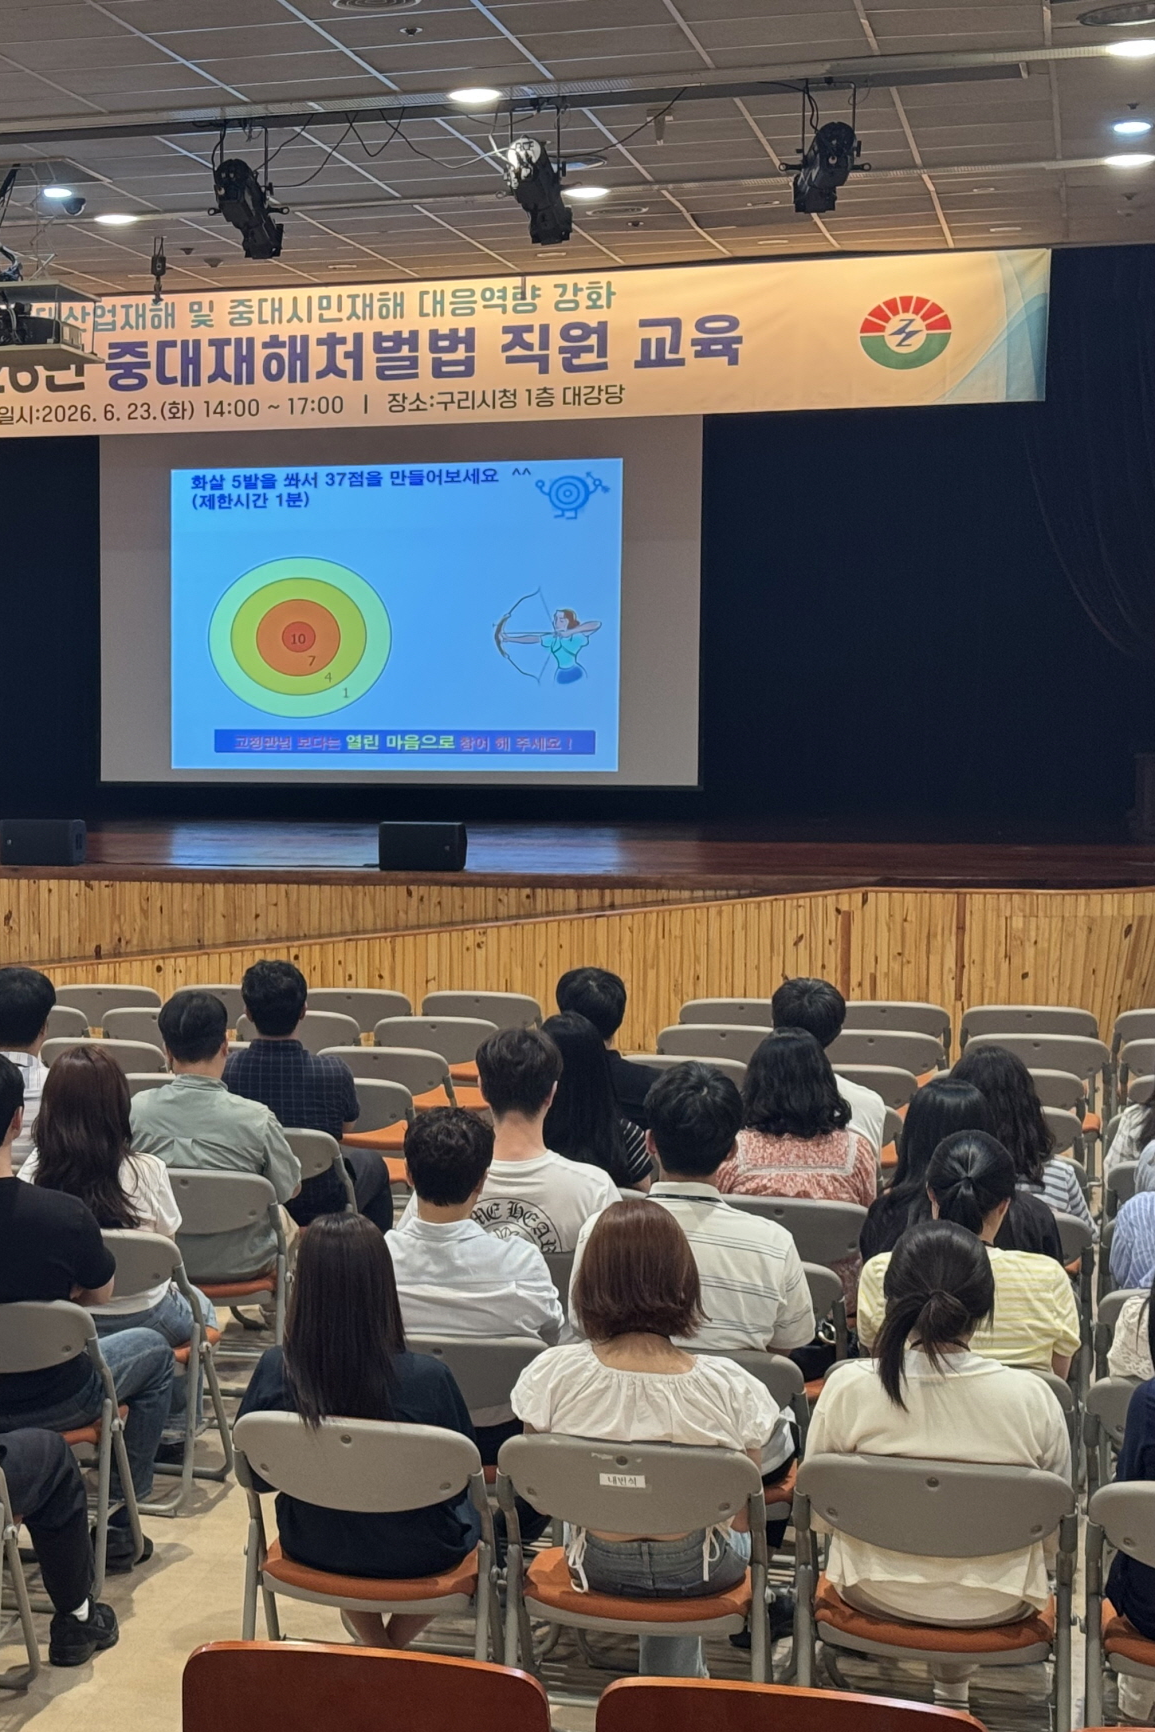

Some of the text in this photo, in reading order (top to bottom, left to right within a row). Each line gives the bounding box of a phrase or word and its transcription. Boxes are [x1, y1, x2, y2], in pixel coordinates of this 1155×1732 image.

[187, 299, 215, 329] 및
[227, 291, 405, 327] 중대시민재해
[418, 284, 542, 318] 대응역량
[552, 280, 617, 313] 강화
[104, 327, 477, 393] 중대재해처벌법
[500, 320, 609, 376] 직원
[633, 313, 744, 370] 교육
[103, 403, 122, 422] 6.
[127, 400, 195, 422] 23.(화)
[203, 398, 260, 418] 14:00
[287, 395, 344, 416] 17:00
[387, 387, 518, 413] 장소:구리시청
[524, 386, 556, 408] 1층
[562, 383, 626, 407] 대강당
[190, 473, 226, 492] 화살
[231, 472, 278, 490] 5발을
[283, 471, 319, 489] 쏴서
[325, 470, 384, 488] 37점을
[389, 467, 500, 487] 만들어보세요
[192, 491, 311, 511] (제한시간 1분)
[291, 633, 307, 646] 10
[308, 655, 317, 667] 7
[324, 671, 333, 683] 4
[343, 687, 350, 699] 1
[297, 735, 342, 750] 보다는
[346, 733, 380, 750] 열린
[386, 733, 456, 751] 마음으로
[460, 736, 490, 752] 참여
[495, 736, 511, 752] 해
[515, 736, 562, 752] 주세요
